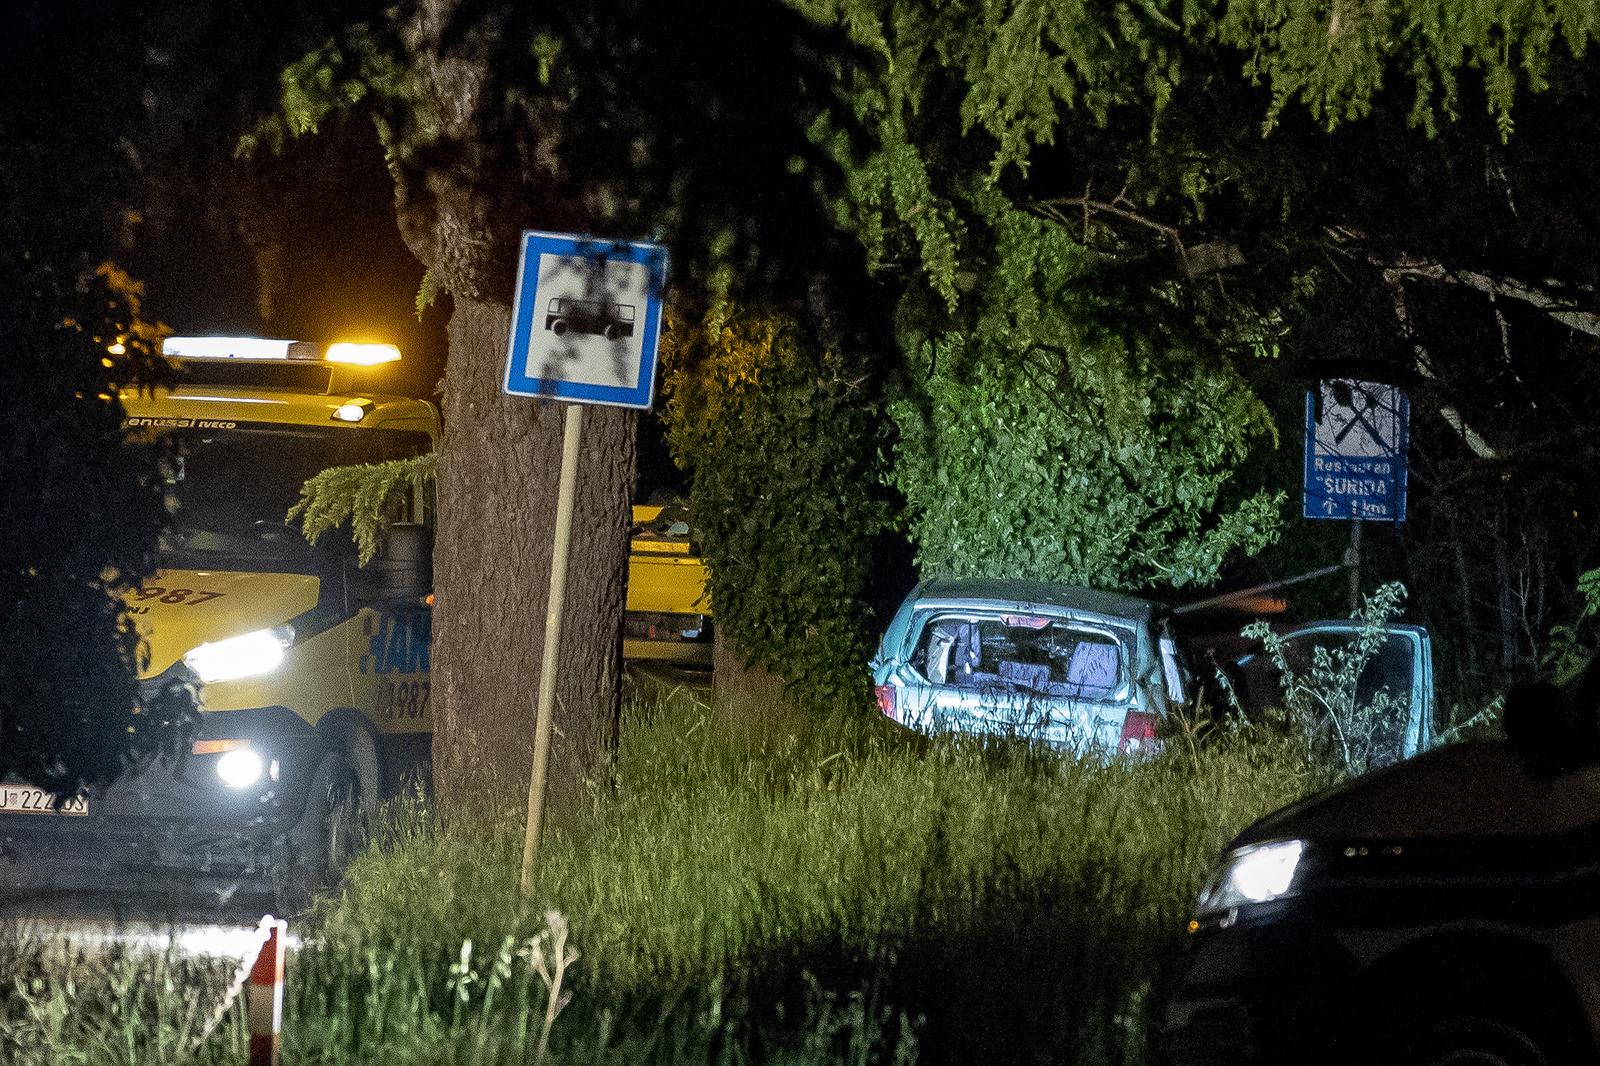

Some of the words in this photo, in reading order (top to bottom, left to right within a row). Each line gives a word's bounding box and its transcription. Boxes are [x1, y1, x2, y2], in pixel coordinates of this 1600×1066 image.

[127, 418, 195, 428] enussi
[198, 421, 237, 430] IVECO
[1362, 499, 1387, 517] km
[136, 586, 226, 606] 987
